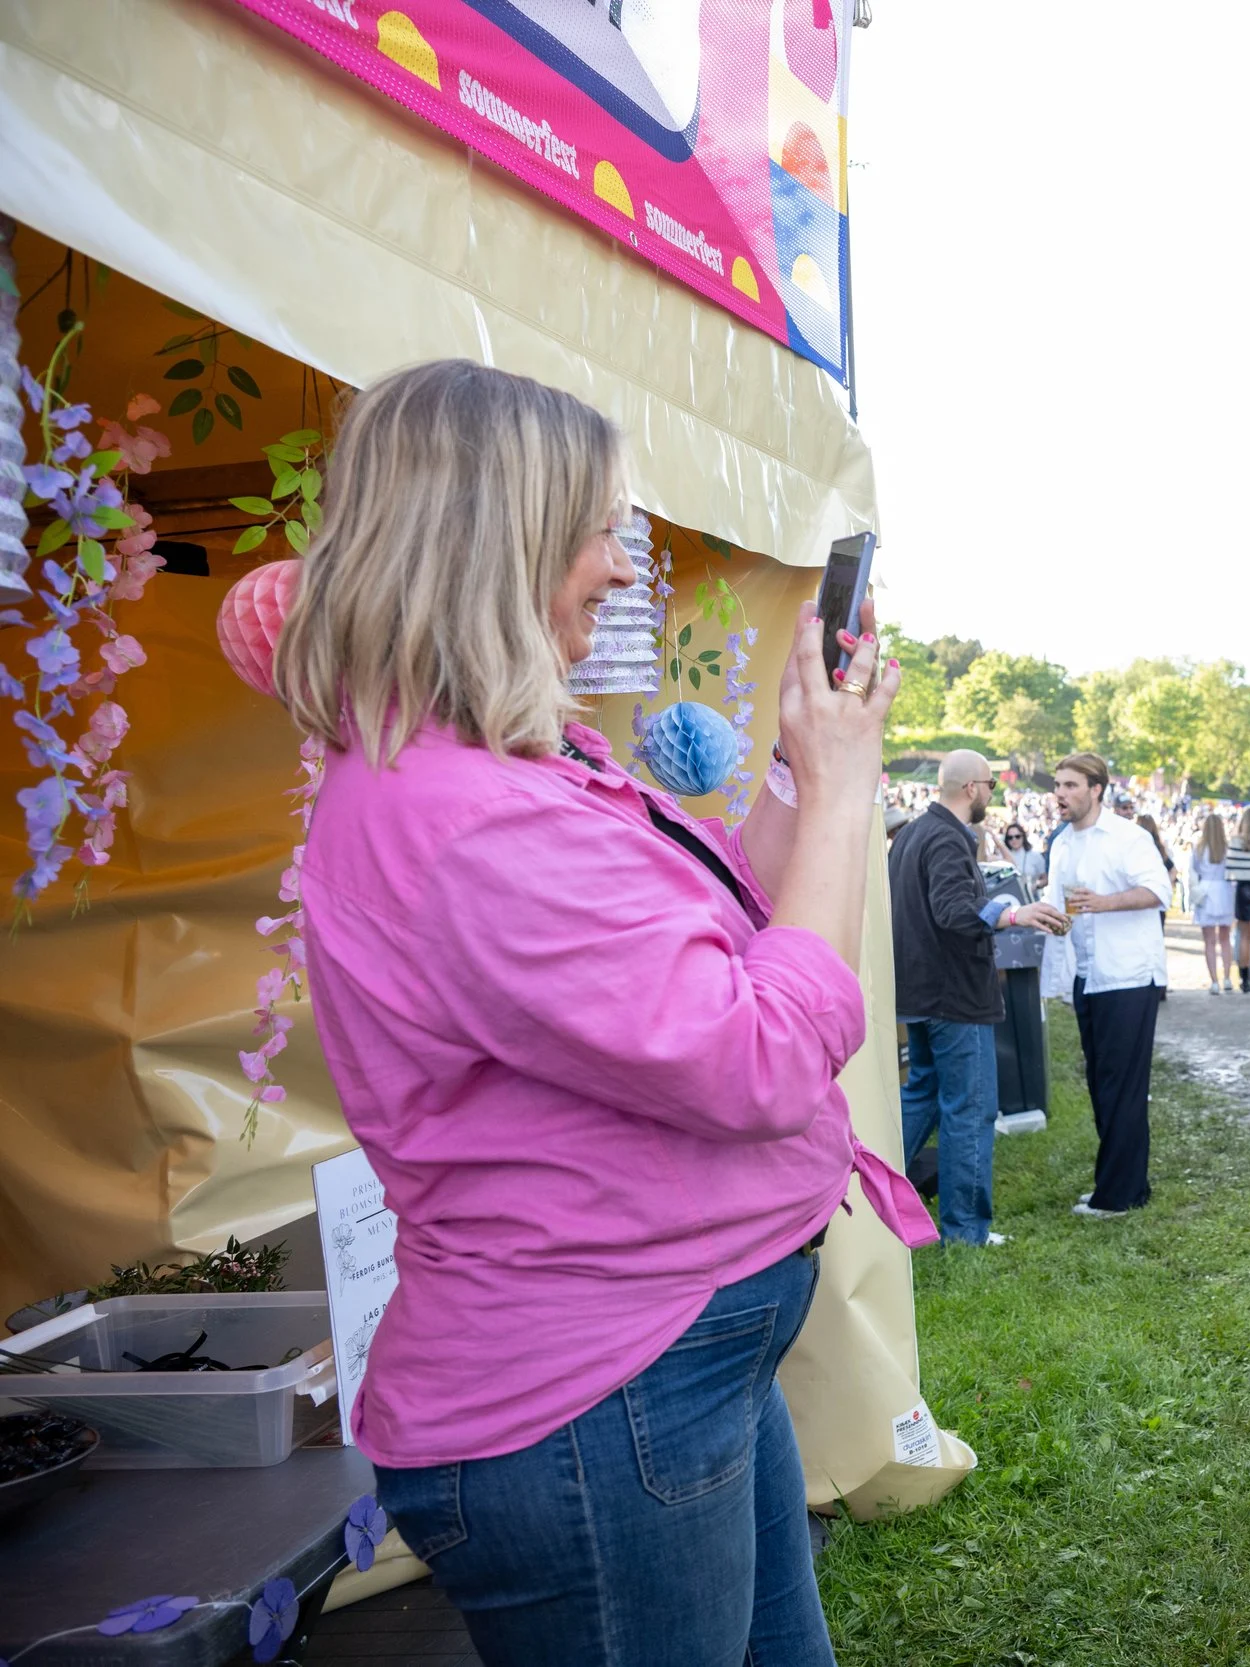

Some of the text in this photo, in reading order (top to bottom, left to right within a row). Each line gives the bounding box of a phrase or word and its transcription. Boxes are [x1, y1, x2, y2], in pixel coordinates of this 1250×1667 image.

[458, 69, 580, 180] sommerfest
[644, 199, 725, 277] sommerfest
[351, 1263, 376, 1281] FERDIG
[363, 1307, 380, 1323] LAG
